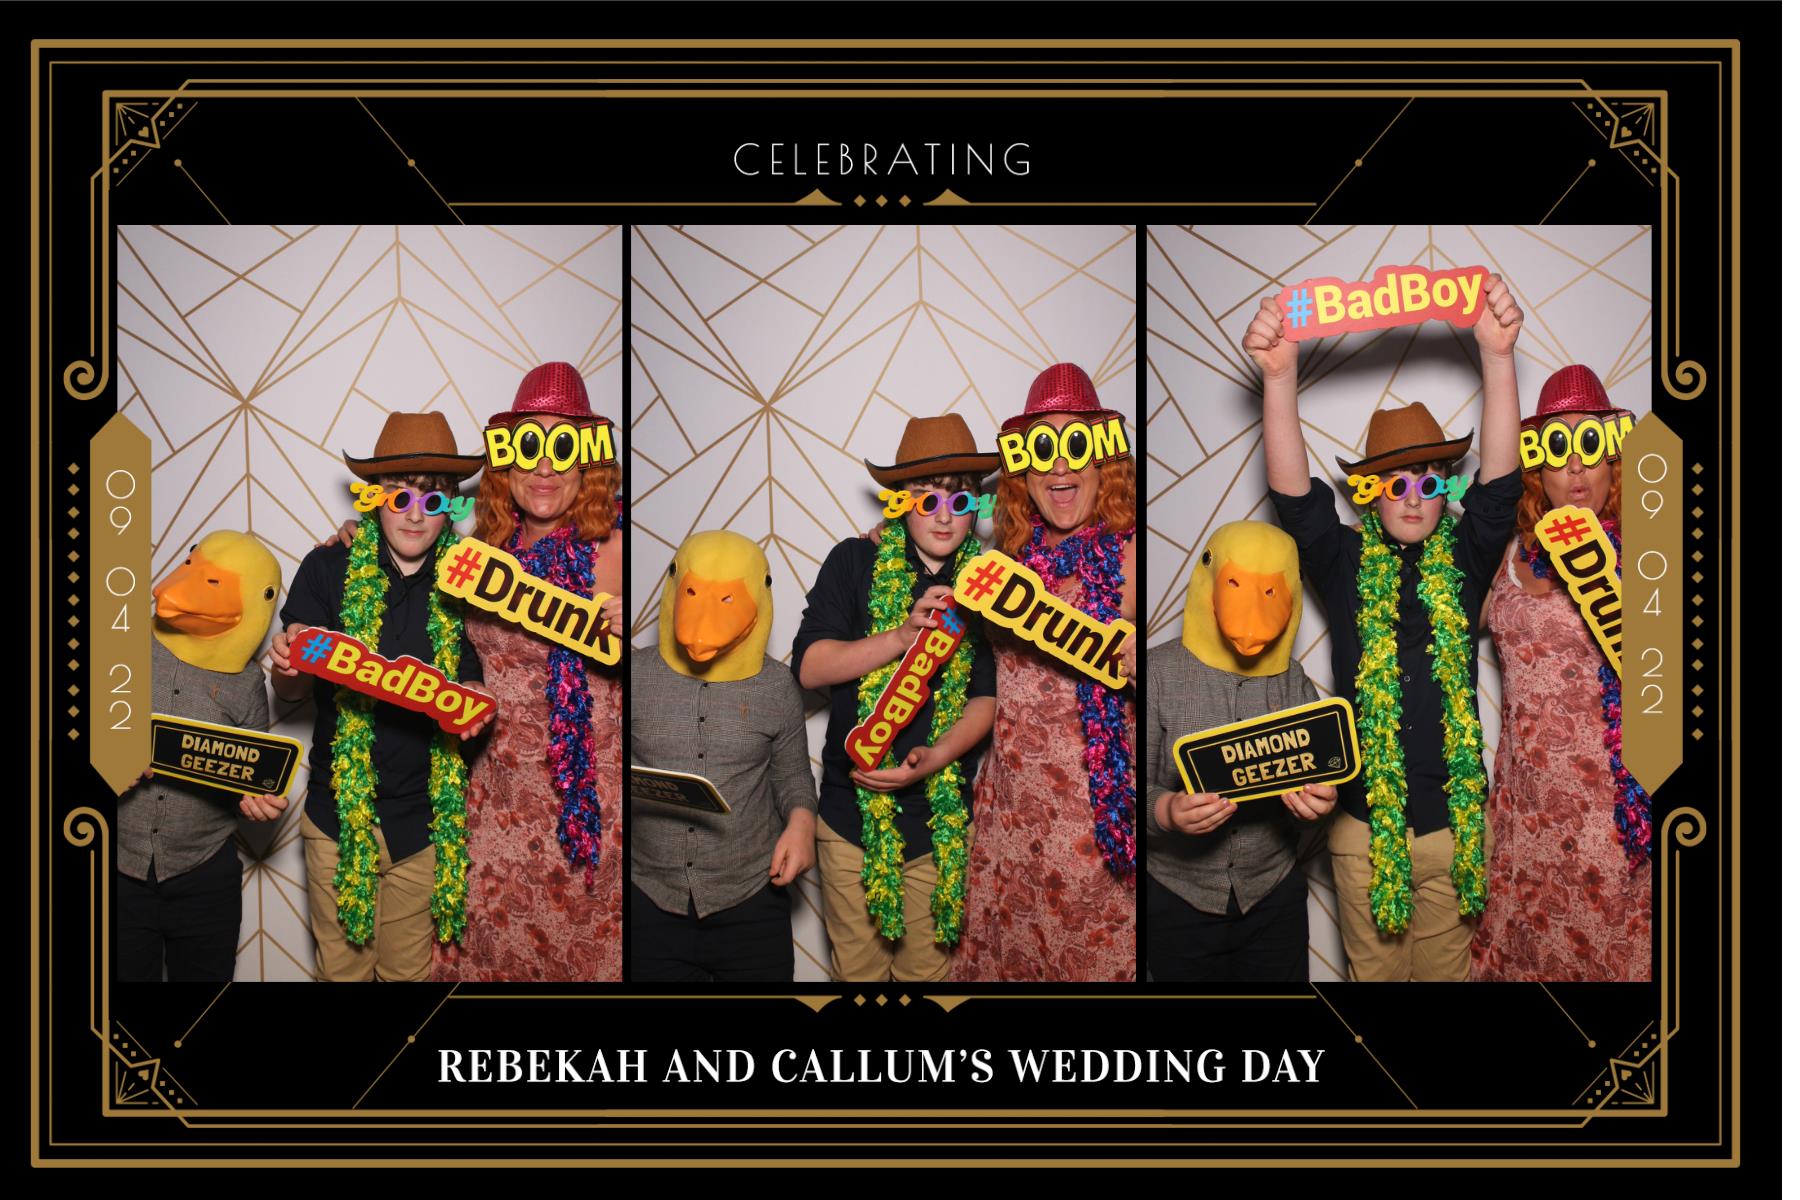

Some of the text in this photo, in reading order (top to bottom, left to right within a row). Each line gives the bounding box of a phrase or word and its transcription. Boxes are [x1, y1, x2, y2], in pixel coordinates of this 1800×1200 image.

[1286, 273, 1483, 328] #BadBoy
[485, 420, 615, 472] BOOM
[999, 417, 1129, 474] BOOM
[1520, 415, 1633, 468] BOOM
[446, 546, 611, 656] #Drunk
[1544, 515, 1622, 664] #Dru
[963, 560, 1126, 680] #Drunk
[301, 633, 489, 726] #BadBoy
[854, 607, 965, 767] #BadBoy
[180, 753, 255, 782] GEEZER
[181, 733, 261, 763] DIAMOND
[1221, 728, 1311, 764] DIAMOND
[1231, 752, 1318, 787] GEEZER
